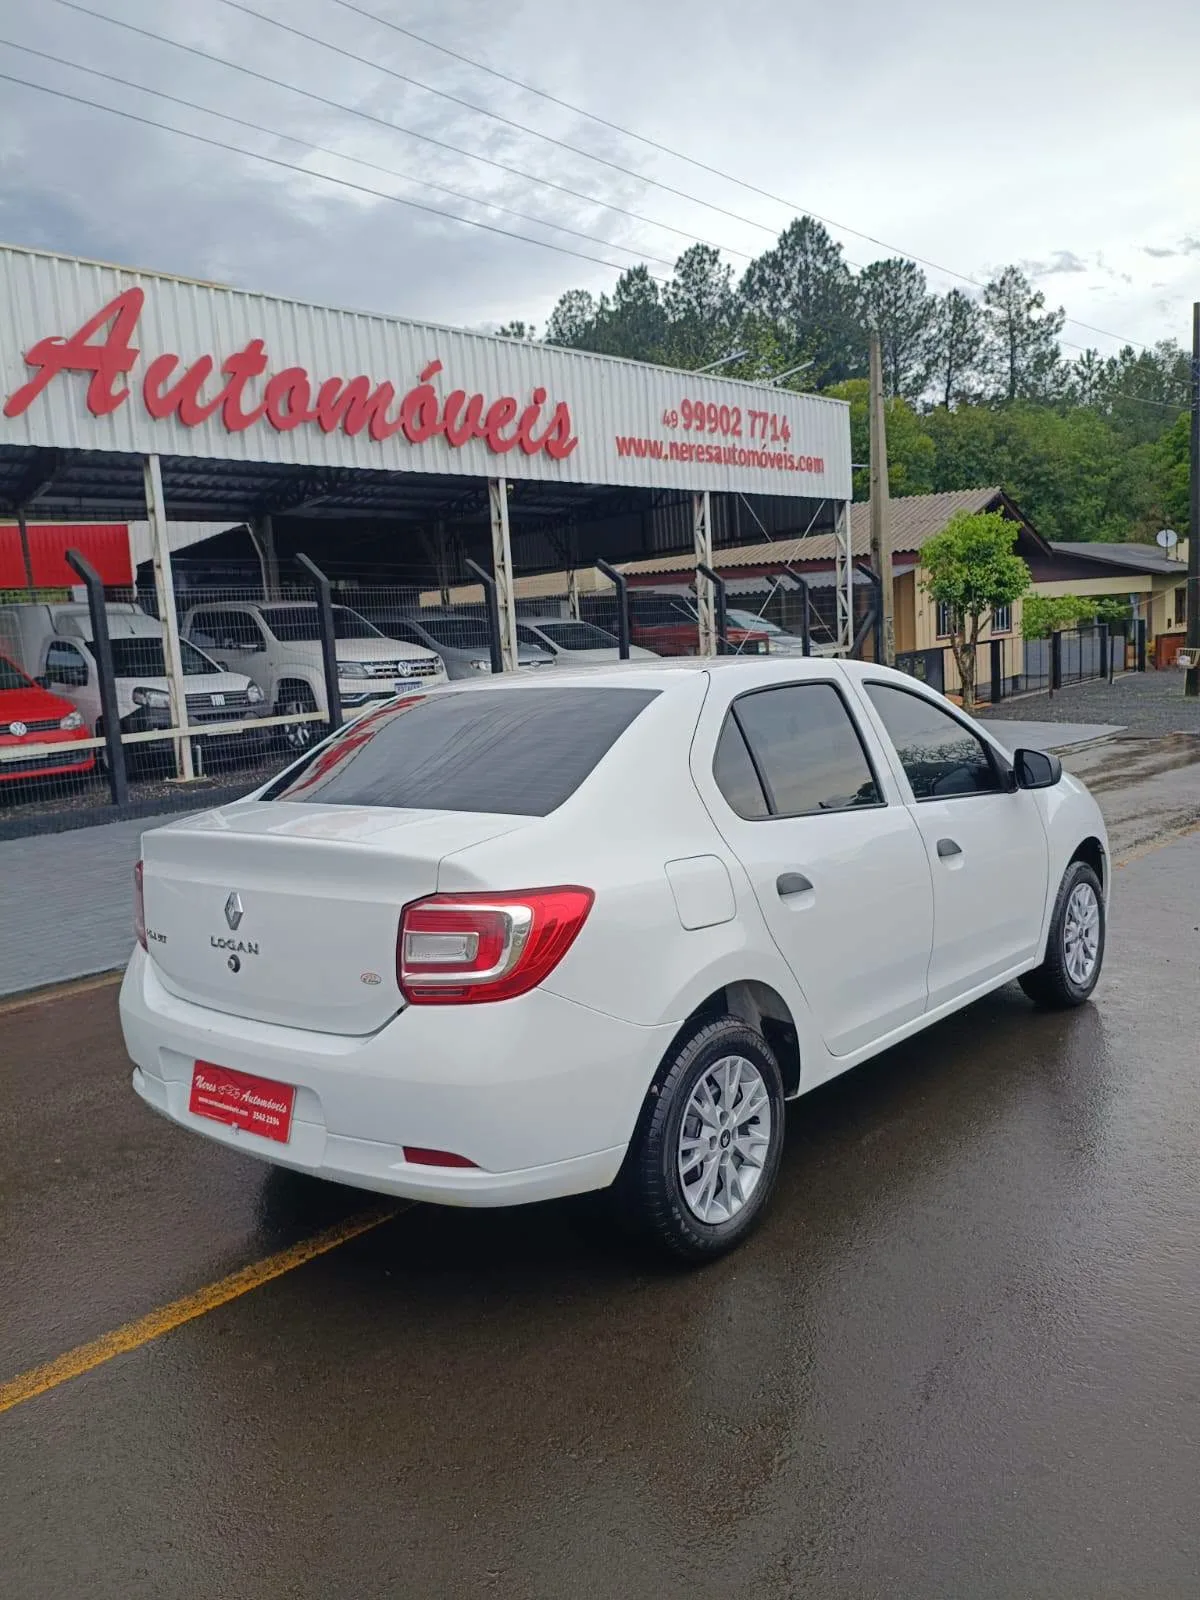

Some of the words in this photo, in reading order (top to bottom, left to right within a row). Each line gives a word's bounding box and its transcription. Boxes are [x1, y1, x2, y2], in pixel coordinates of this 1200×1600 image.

[4, 286, 578, 460] Automóveis
[662, 409, 678, 428] 49
[680, 398, 742, 437] 99902
[748, 409, 791, 443] 7714
[615, 435, 825, 474] www.neresautomóveis.com
[210, 936, 260, 955] LOGAN
